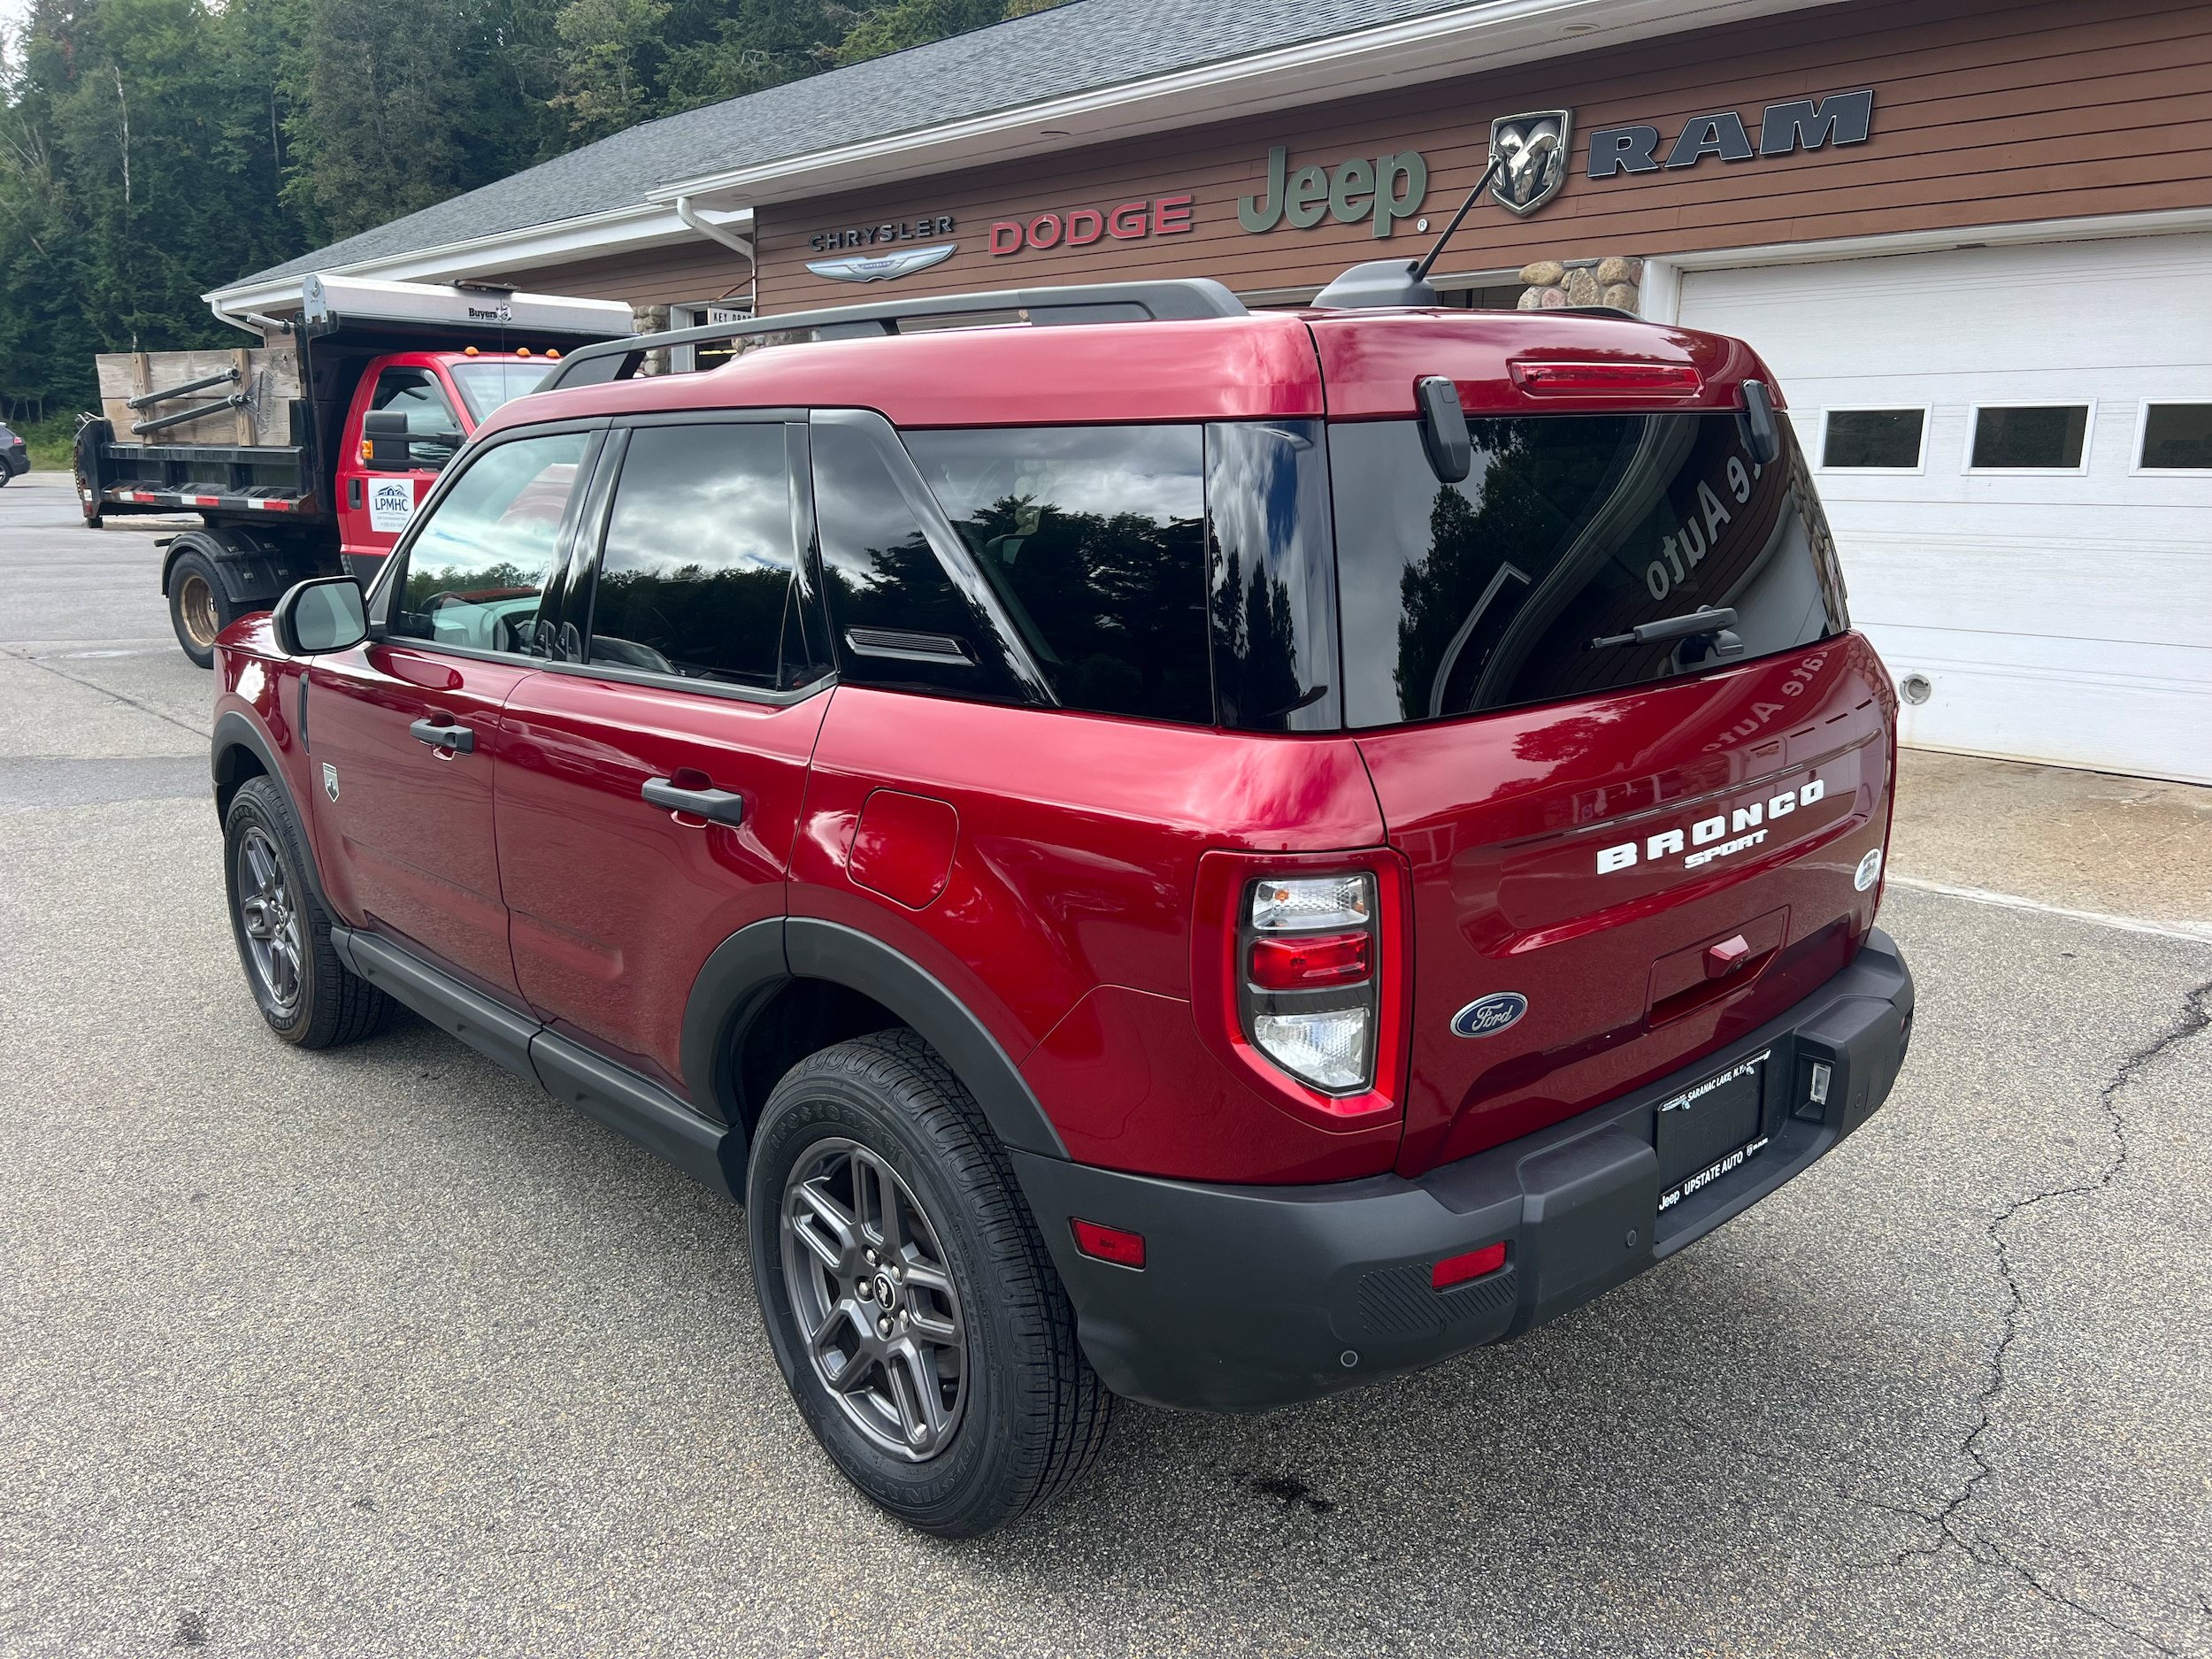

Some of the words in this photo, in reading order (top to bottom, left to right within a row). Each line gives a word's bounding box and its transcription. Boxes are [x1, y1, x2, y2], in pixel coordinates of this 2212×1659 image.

[1587, 89, 1873, 178] RAM
[1238, 145, 1428, 238] Jeep
[808, 215, 953, 252] CHRYSLER
[989, 194, 1193, 256] DODGE
[468, 307, 498, 319] Buyers
[713, 312, 727, 323] KEY
[375, 498, 409, 511] LPMHC
[1596, 779, 1824, 875] BRONCO
[1684, 828, 1769, 869] SPORT
[1471, 1002, 1514, 1032] Ford
[1687, 1079, 1717, 1102] SARANAC
[1684, 1163, 1721, 1196] UPSTATE
[1721, 1150, 1743, 1174] AUTO
[1658, 1190, 1680, 1210] Jeep
